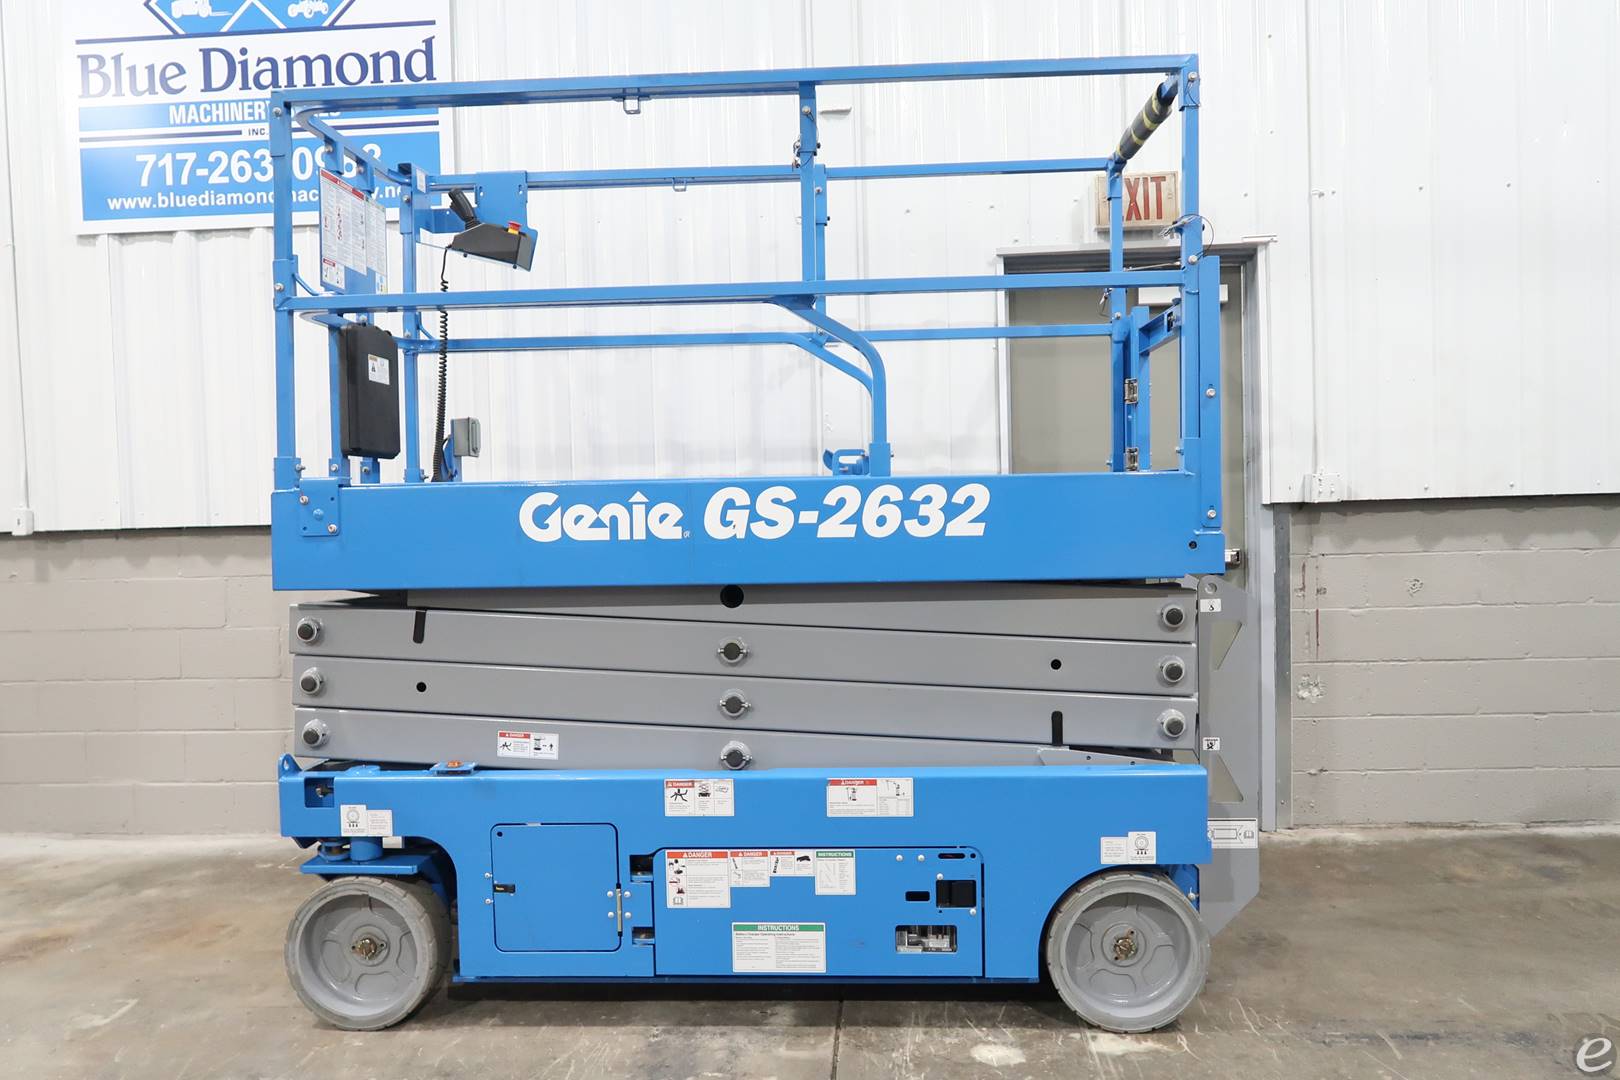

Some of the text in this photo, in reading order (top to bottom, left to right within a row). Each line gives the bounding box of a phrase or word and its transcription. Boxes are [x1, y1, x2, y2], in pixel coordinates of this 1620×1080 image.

[77, 36, 436, 98] Blue Diamond
[136, 143, 382, 187] 717-26306
[1122, 176, 1166, 221] XIT
[519, 483, 990, 542] Genie GS-2632
